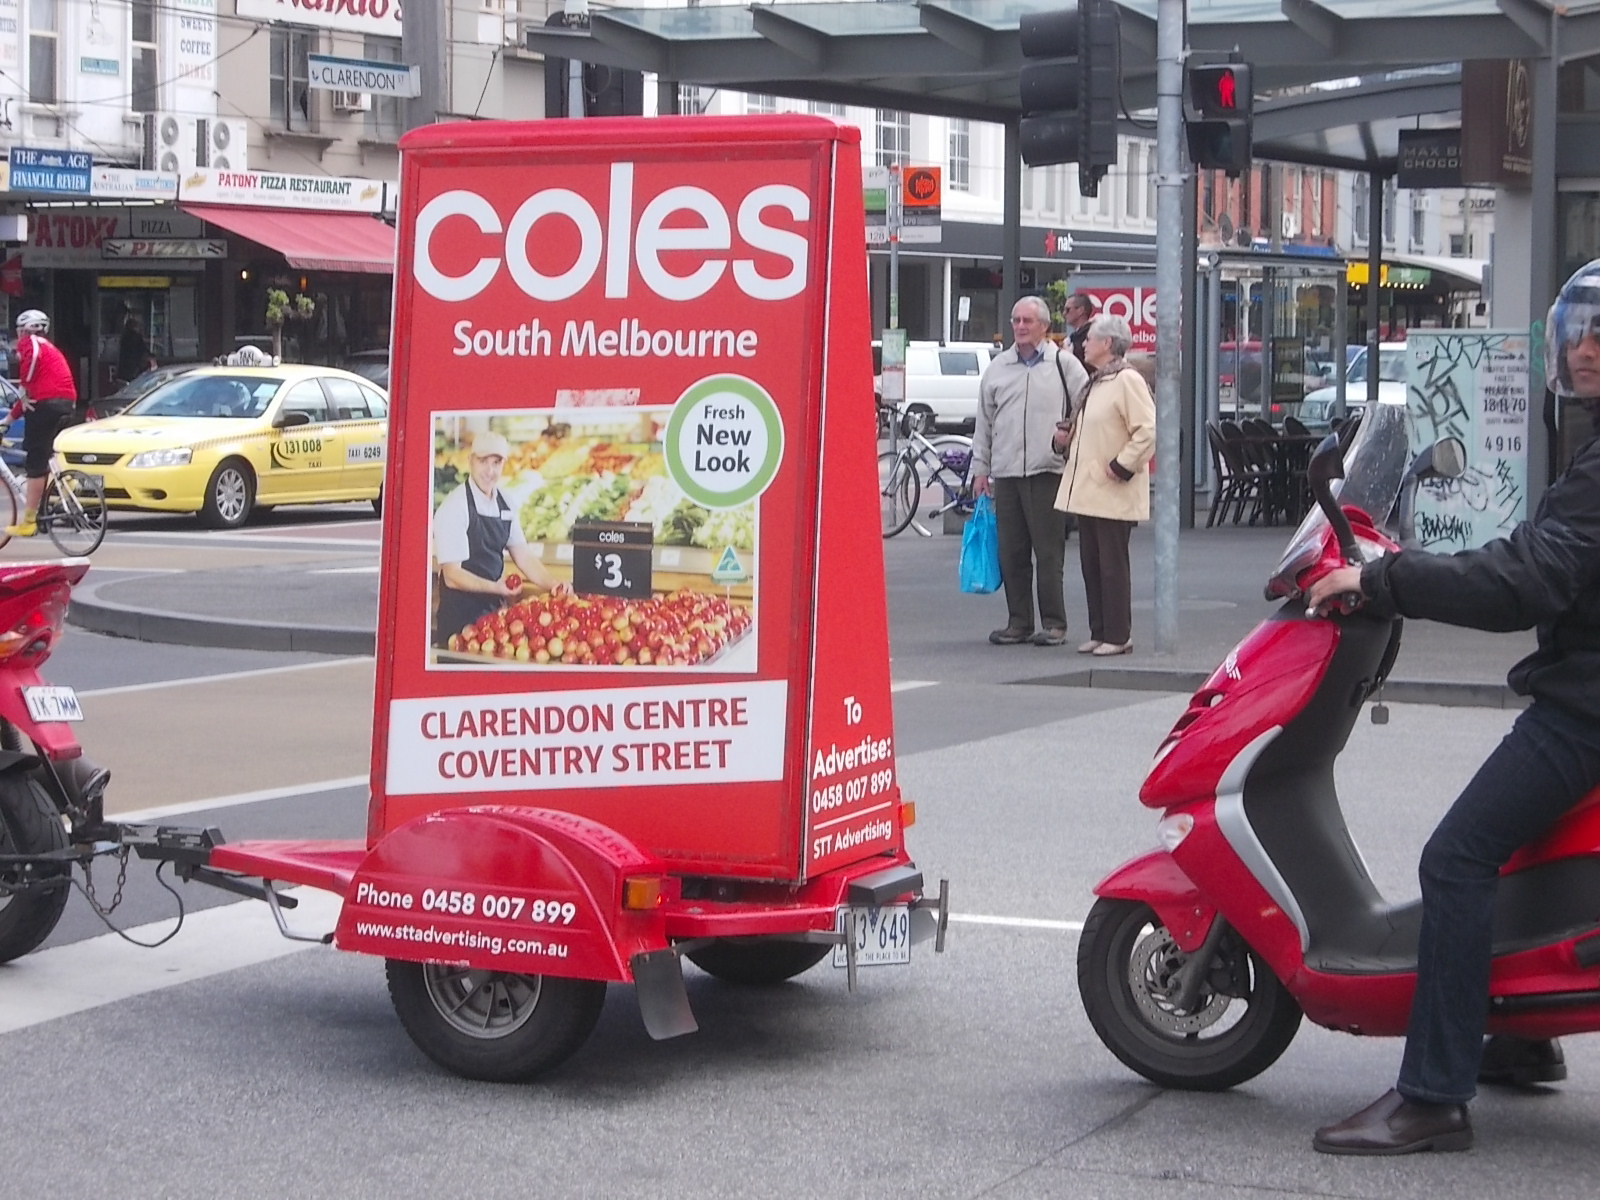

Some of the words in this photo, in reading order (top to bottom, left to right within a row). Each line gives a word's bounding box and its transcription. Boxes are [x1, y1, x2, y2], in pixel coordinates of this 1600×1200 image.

[180, 16, 213, 32] SWEETS
[180, 39, 212, 55] COFFEE
[322, 67, 396, 90] CLARENDON
[14, 150, 38, 165] THE
[66, 155, 89, 169] AGE
[1404, 146, 1439, 157] MAX
[1447, 146, 1462, 157] B
[1404, 159, 1462, 169] CHOCO
[13, 171, 56, 188] FINANCIAL
[57, 173, 87, 191] REVIEW
[93, 181, 134, 193] AUSTRALIAN
[218, 173, 258, 188] PATONY
[260, 175, 287, 191] PIZZA
[289, 178, 352, 195] RESTAURANT
[140, 219, 172, 235] PIZZA
[412, 161, 811, 302] coles
[130, 241, 202, 256] PIZZA
[452, 317, 551, 357] South
[560, 317, 758, 358] Melbourne
[703, 404, 745, 421] Fresh
[284, 440, 300, 454] 131
[302, 438, 322, 453] 008
[696, 423, 752, 447] New
[348, 447, 361, 459] TAXI
[363, 445, 381, 459] 6249
[694, 448, 751, 473] Look
[598, 530, 625, 544] coles
[420, 702, 614, 741] CLARENDON
[623, 696, 748, 732] CENTRE
[843, 695, 862, 726] To
[437, 744, 604, 779] COVENTRY
[612, 739, 733, 773] STREET
[812, 735, 892, 780] Advertise:
[812, 785, 843, 814] 0458
[845, 775, 868, 803] 007
[870, 767, 893, 795] 899
[813, 834, 832, 860] STT
[834, 818, 892, 851] Advertising
[355, 881, 414, 910] Phone
[421, 888, 476, 916] 0458
[482, 894, 526, 921] 007
[531, 899, 577, 926] 899
[355, 921, 569, 959] www.sttadvertising.com.au
[879, 912, 907, 949] 649
